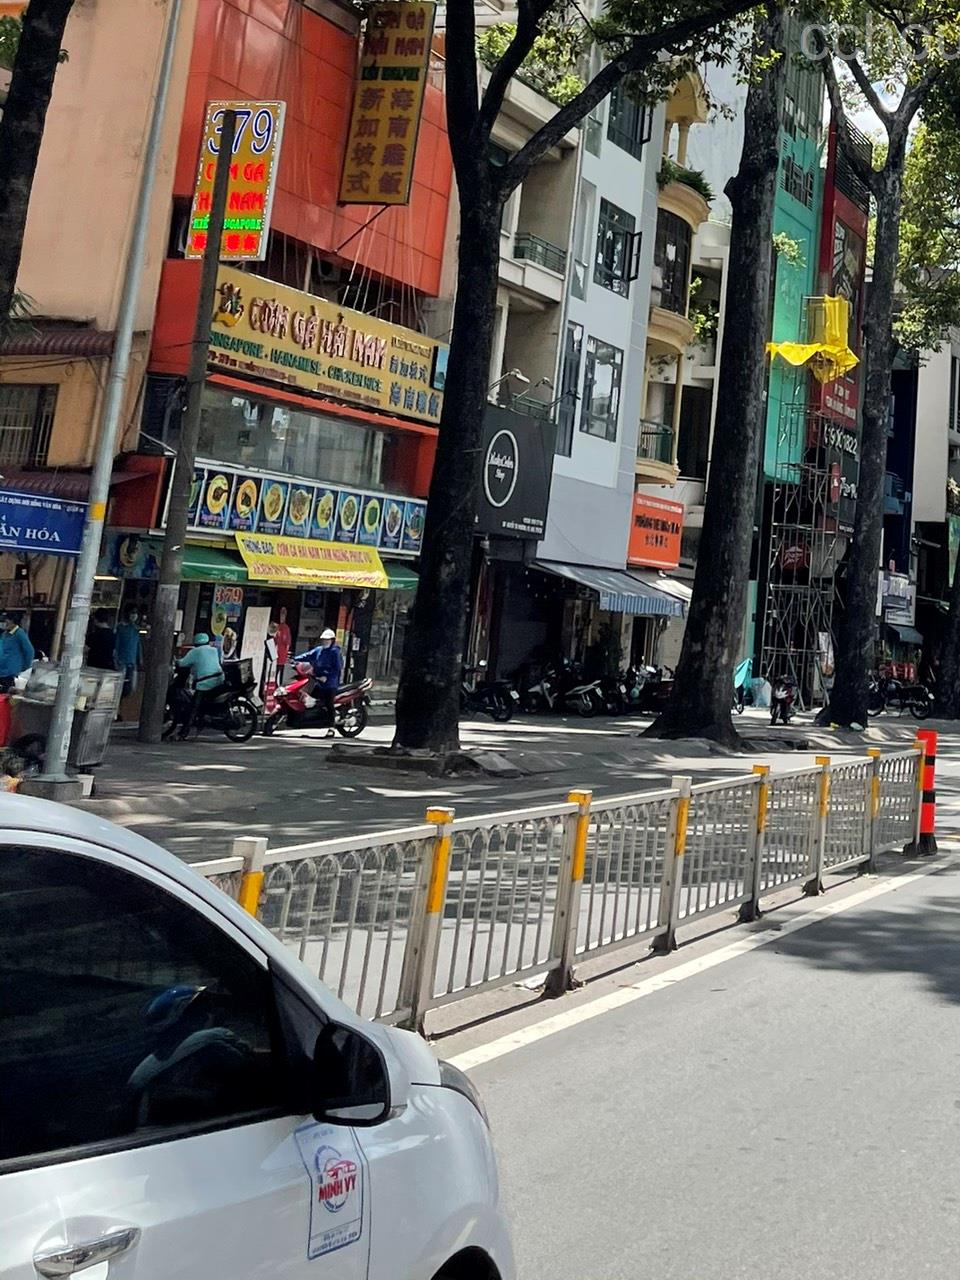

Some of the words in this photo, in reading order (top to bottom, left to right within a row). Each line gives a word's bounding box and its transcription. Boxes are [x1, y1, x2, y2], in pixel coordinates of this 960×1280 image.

[207, 108, 274, 154] 379
[229, 192, 264, 211] NAM
[350, 329, 387, 370] NAM
[25, 527, 60, 542] HÓA
[216, 586, 243, 603] 379
[318, 1179, 343, 1203] MINH
[344, 1174, 357, 1193] VY
